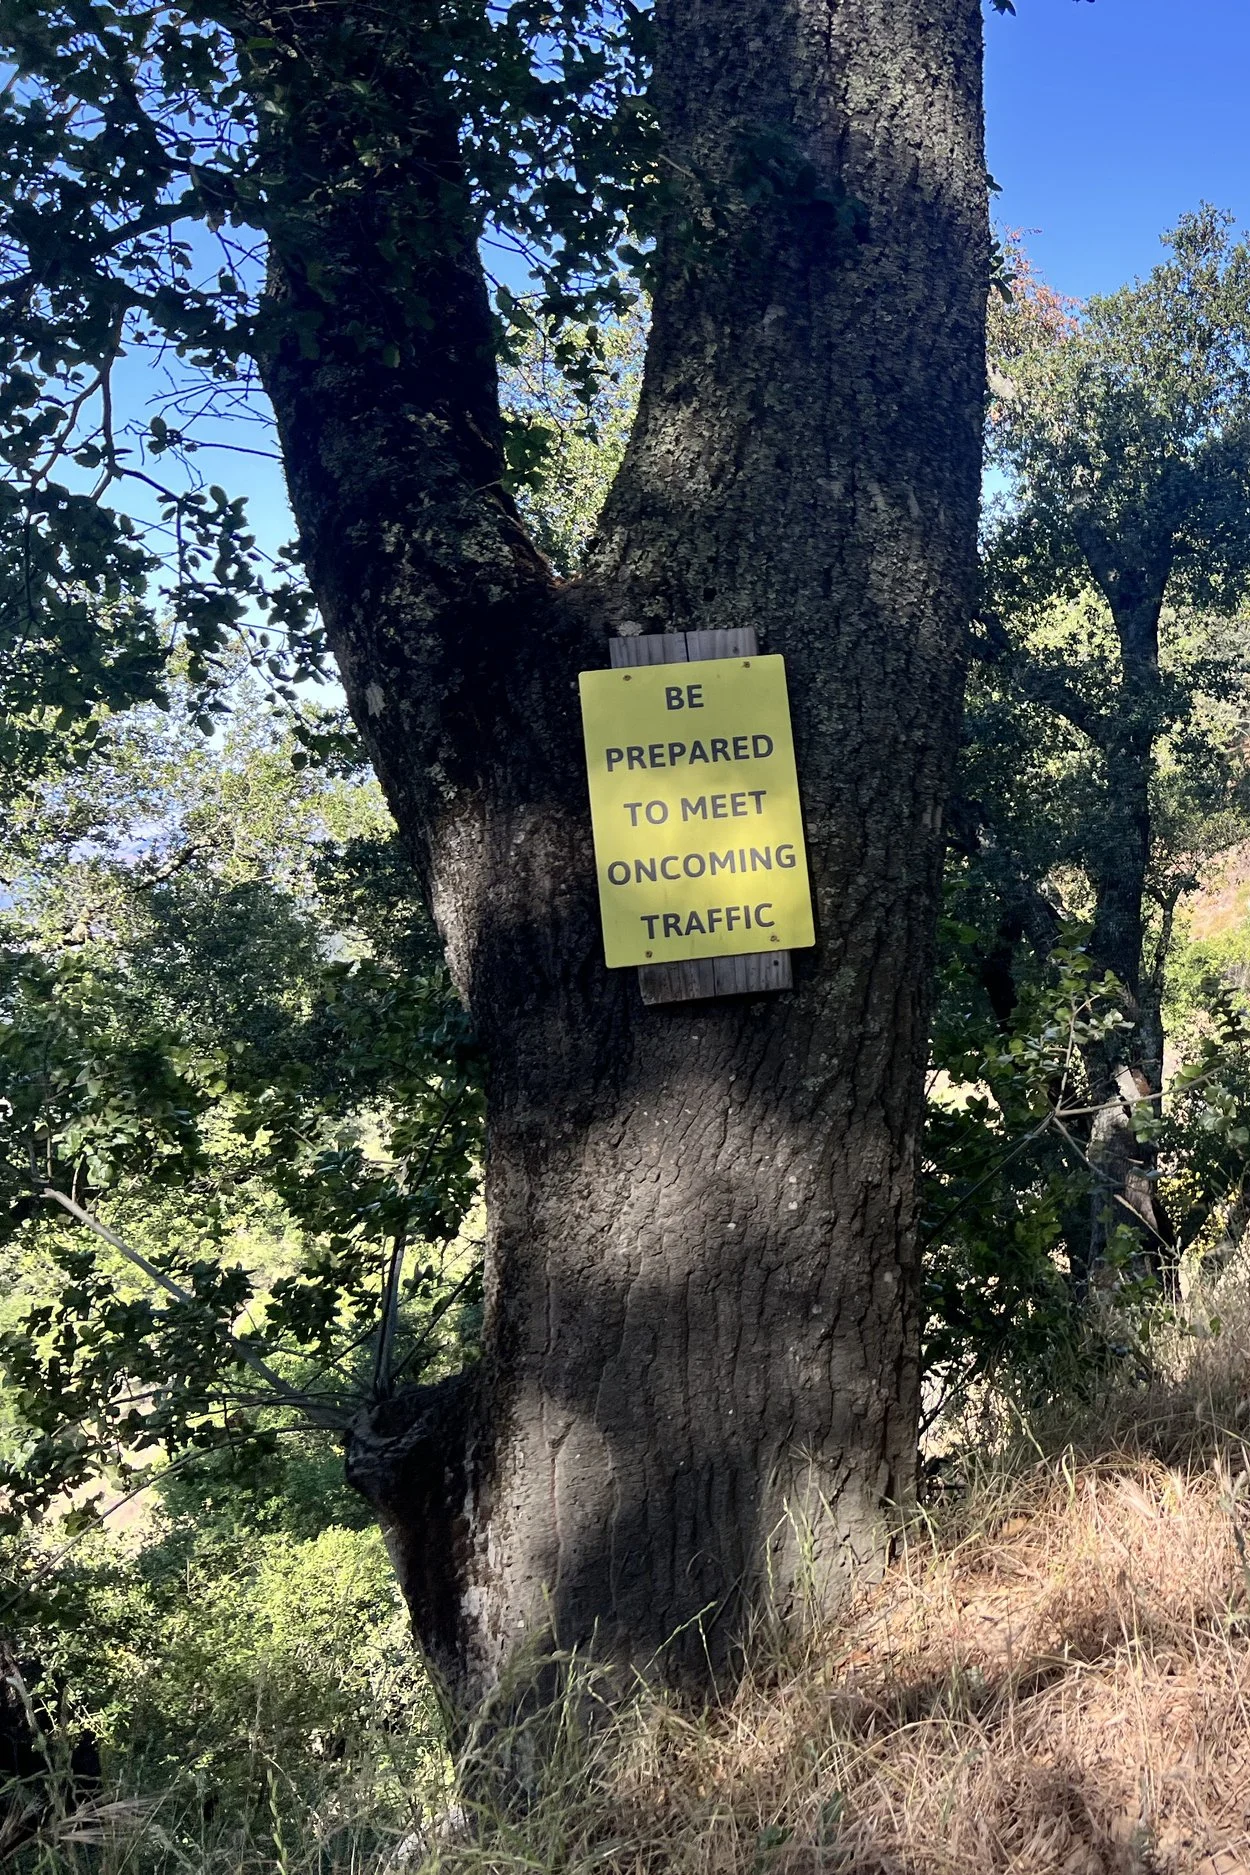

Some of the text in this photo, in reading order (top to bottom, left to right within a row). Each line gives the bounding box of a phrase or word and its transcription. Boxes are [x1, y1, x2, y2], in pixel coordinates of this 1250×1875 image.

[664, 684, 704, 710] BE
[605, 734, 774, 772] PREPARED
[623, 790, 767, 827] TO MEET
[607, 843, 796, 886] ONCOMING
[640, 903, 775, 939] TRAFFIC
